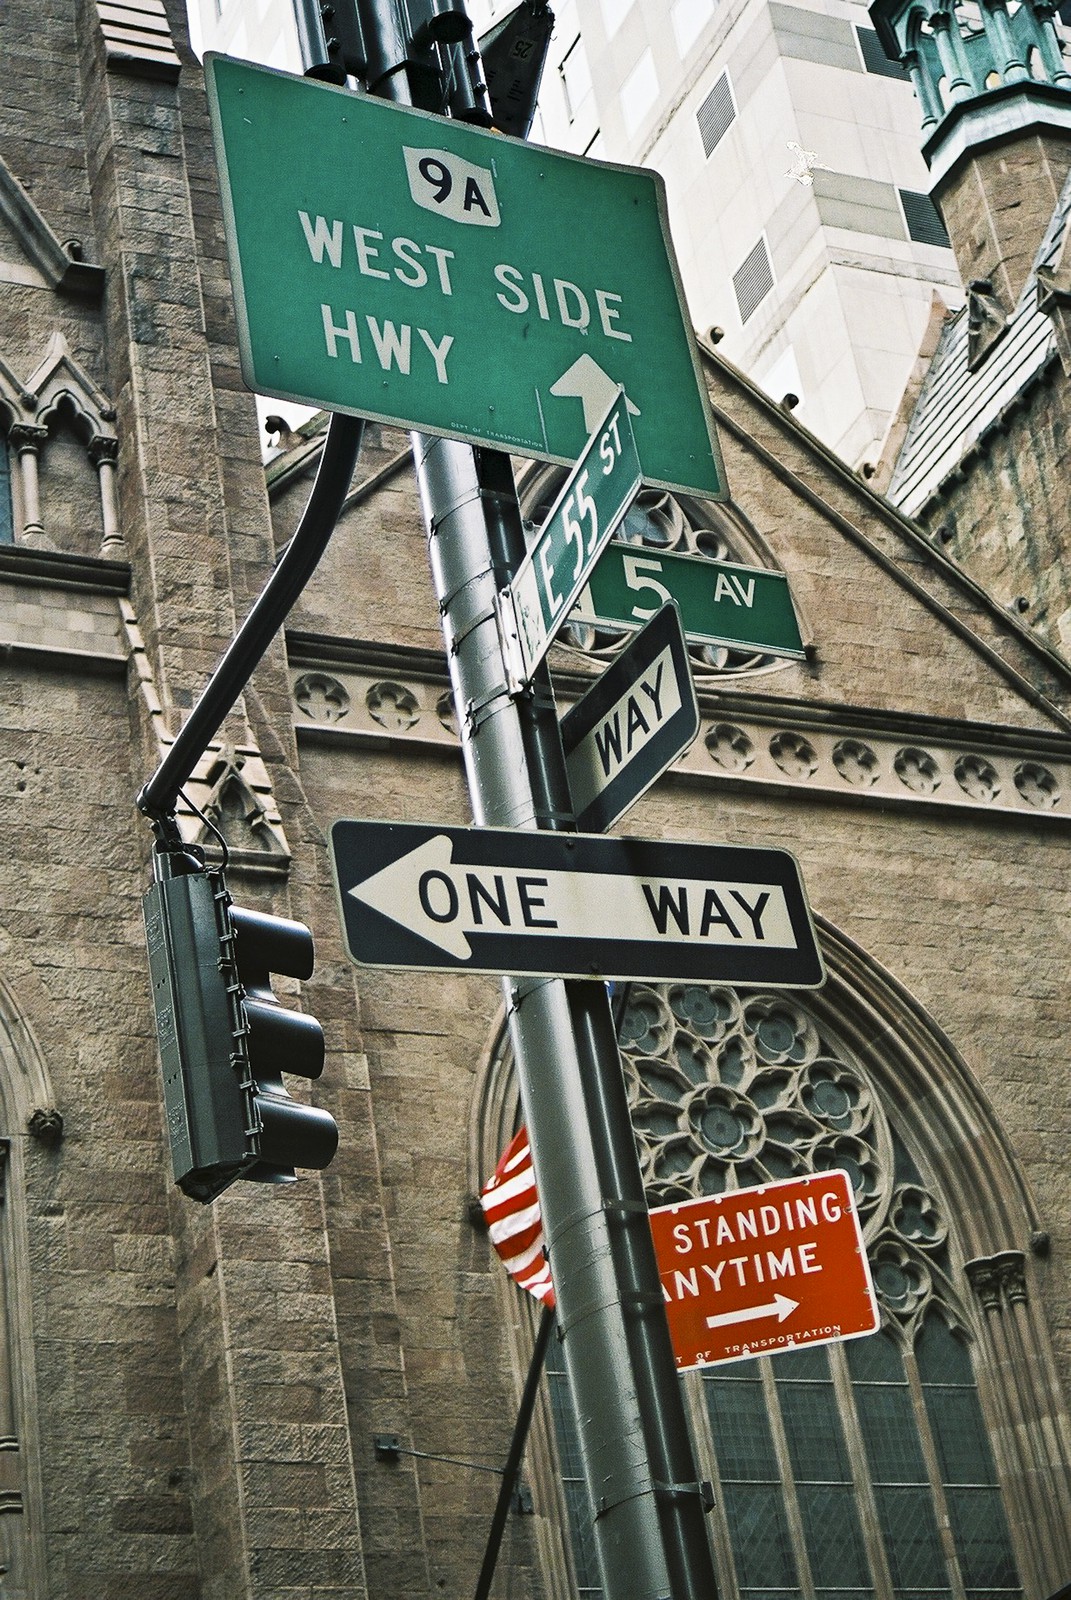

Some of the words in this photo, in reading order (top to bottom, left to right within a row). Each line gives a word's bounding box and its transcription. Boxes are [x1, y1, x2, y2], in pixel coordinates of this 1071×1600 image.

[513, 40, 533, 59] 25
[298, 210, 455, 295] WEST
[494, 264, 633, 343] SIDE
[321, 304, 455, 385] HWY
[451, 422, 468, 430] DEPT
[486, 430, 543, 448] TRANSPORTATION
[539, 535, 564, 619] E
[562, 468, 598, 581] 55
[600, 411, 622, 475] ST
[622, 555, 675, 619] 5
[714, 573, 755, 608] AV
[594, 661, 666, 778] WAY
[418, 869, 558, 929] ONE
[641, 884, 771, 941] WAY
[672, 1192, 842, 1254] STANDING
[696, 1350, 711, 1361] OF
[725, 1325, 841, 1353] TRANSPORTATION
